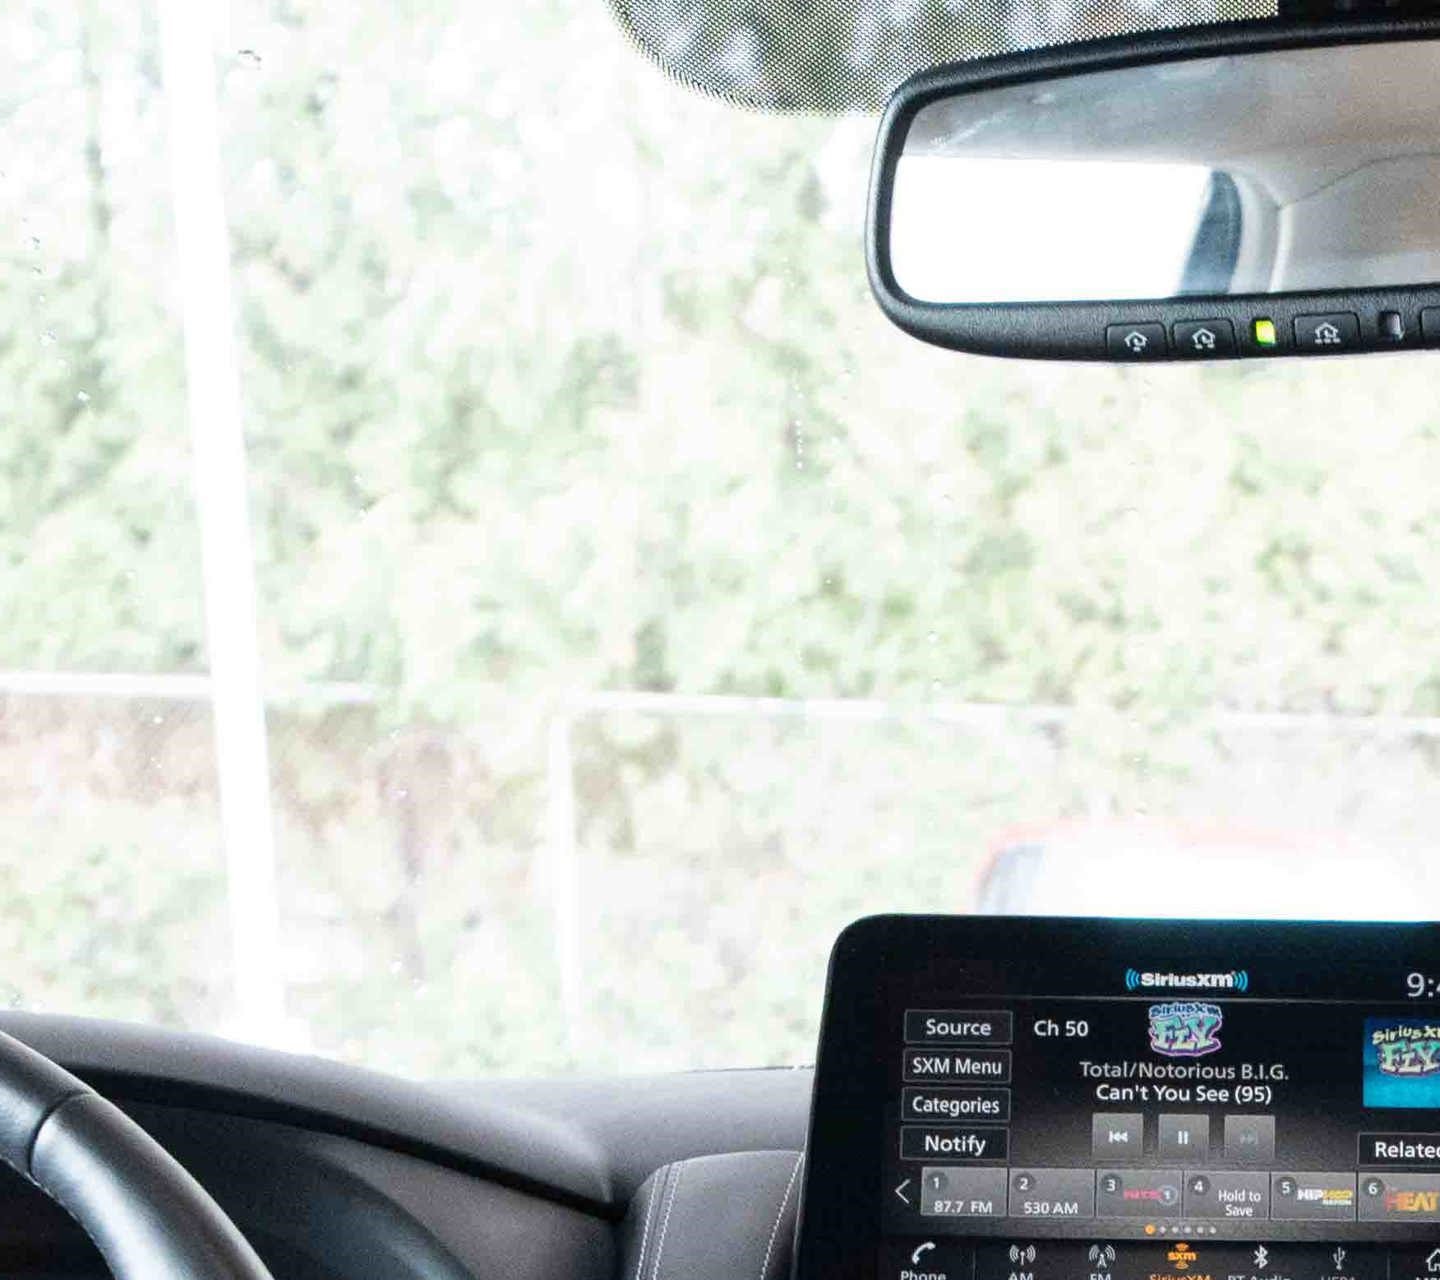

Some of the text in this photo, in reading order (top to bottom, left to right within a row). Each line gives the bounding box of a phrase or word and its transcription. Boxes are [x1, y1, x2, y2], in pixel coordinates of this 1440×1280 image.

[926, 1019, 991, 1036] Source
[1034, 1020, 1089, 1037] Ch 50
[913, 1057, 1002, 1075] SXM Menu
[1079, 1061, 1289, 1080] Total/Notorious B.I.G.
[1096, 1084, 1272, 1105] Can't You See (95)
[912, 1096, 1000, 1117] Categories
[924, 1135, 986, 1156] Notify
[933, 1176, 941, 1189] 1
[1019, 1178, 1029, 1191] 2
[1106, 1179, 1116, 1192] 3
[1194, 1181, 1204, 1192] 4
[1281, 1182, 1291, 1195] 5
[1367, 1182, 1378, 1195] 6
[1218, 1189, 1261, 1202] Hold to
[934, 1200, 992, 1213] 87.7 FM
[1024, 1201, 1079, 1214] 530 AM
[1225, 1204, 1253, 1217] Save
